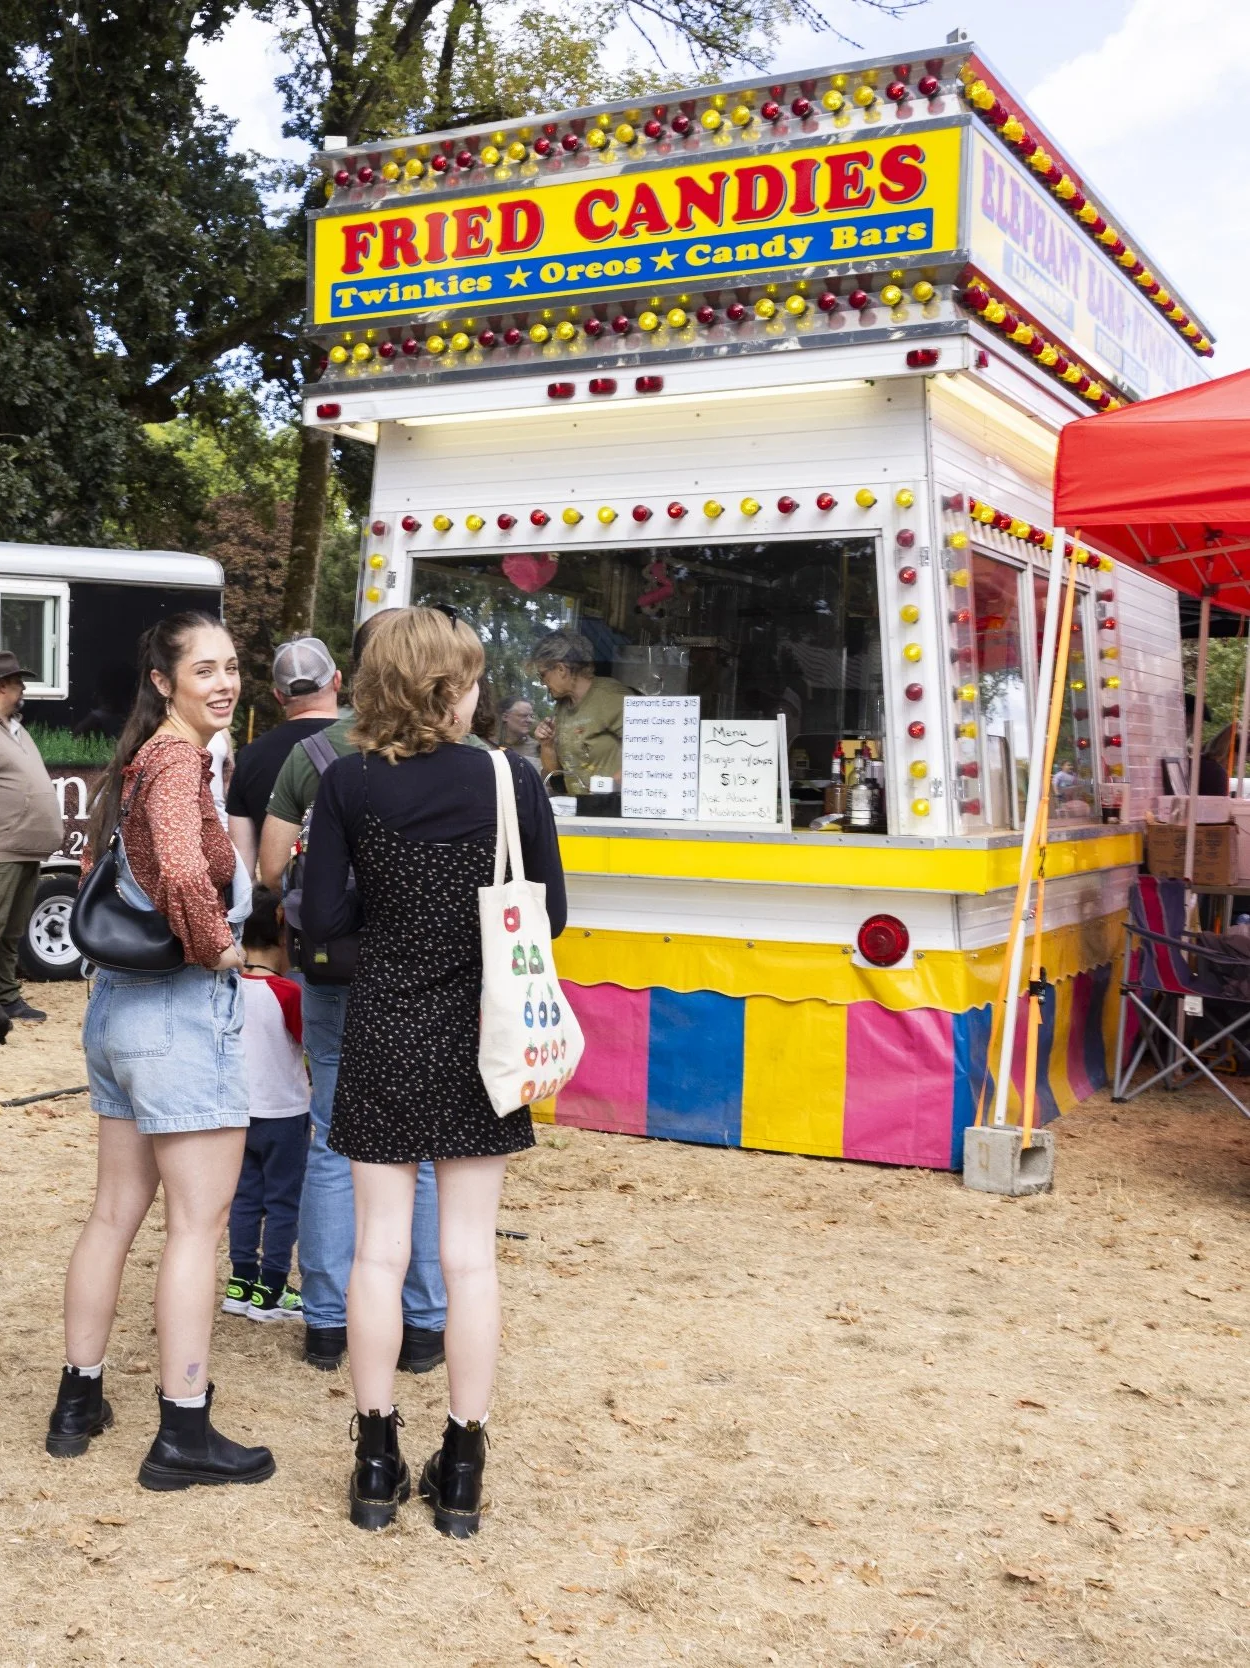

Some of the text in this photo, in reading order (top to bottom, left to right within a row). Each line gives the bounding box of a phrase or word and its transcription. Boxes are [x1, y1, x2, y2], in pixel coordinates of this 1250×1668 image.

[341, 144, 928, 275] FRIED CANDIES
[981, 148, 1082, 300] ELEPHANT
[335, 220, 928, 311] Twinkies Oreos Candy Bars
[626, 699, 660, 707] Elephant
[662, 699, 681, 707] Ears
[625, 717, 649, 725] Funnel
[652, 717, 676, 725] Cakes
[712, 726, 747, 738] Menu
[625, 735, 649, 743] Funnel
[624, 752, 643, 761] Fried
[645, 752, 665, 761] Oreo
[624, 770, 643, 779] Fried
[623, 788, 643, 797] Fried
[624, 806, 643, 814] Fried
